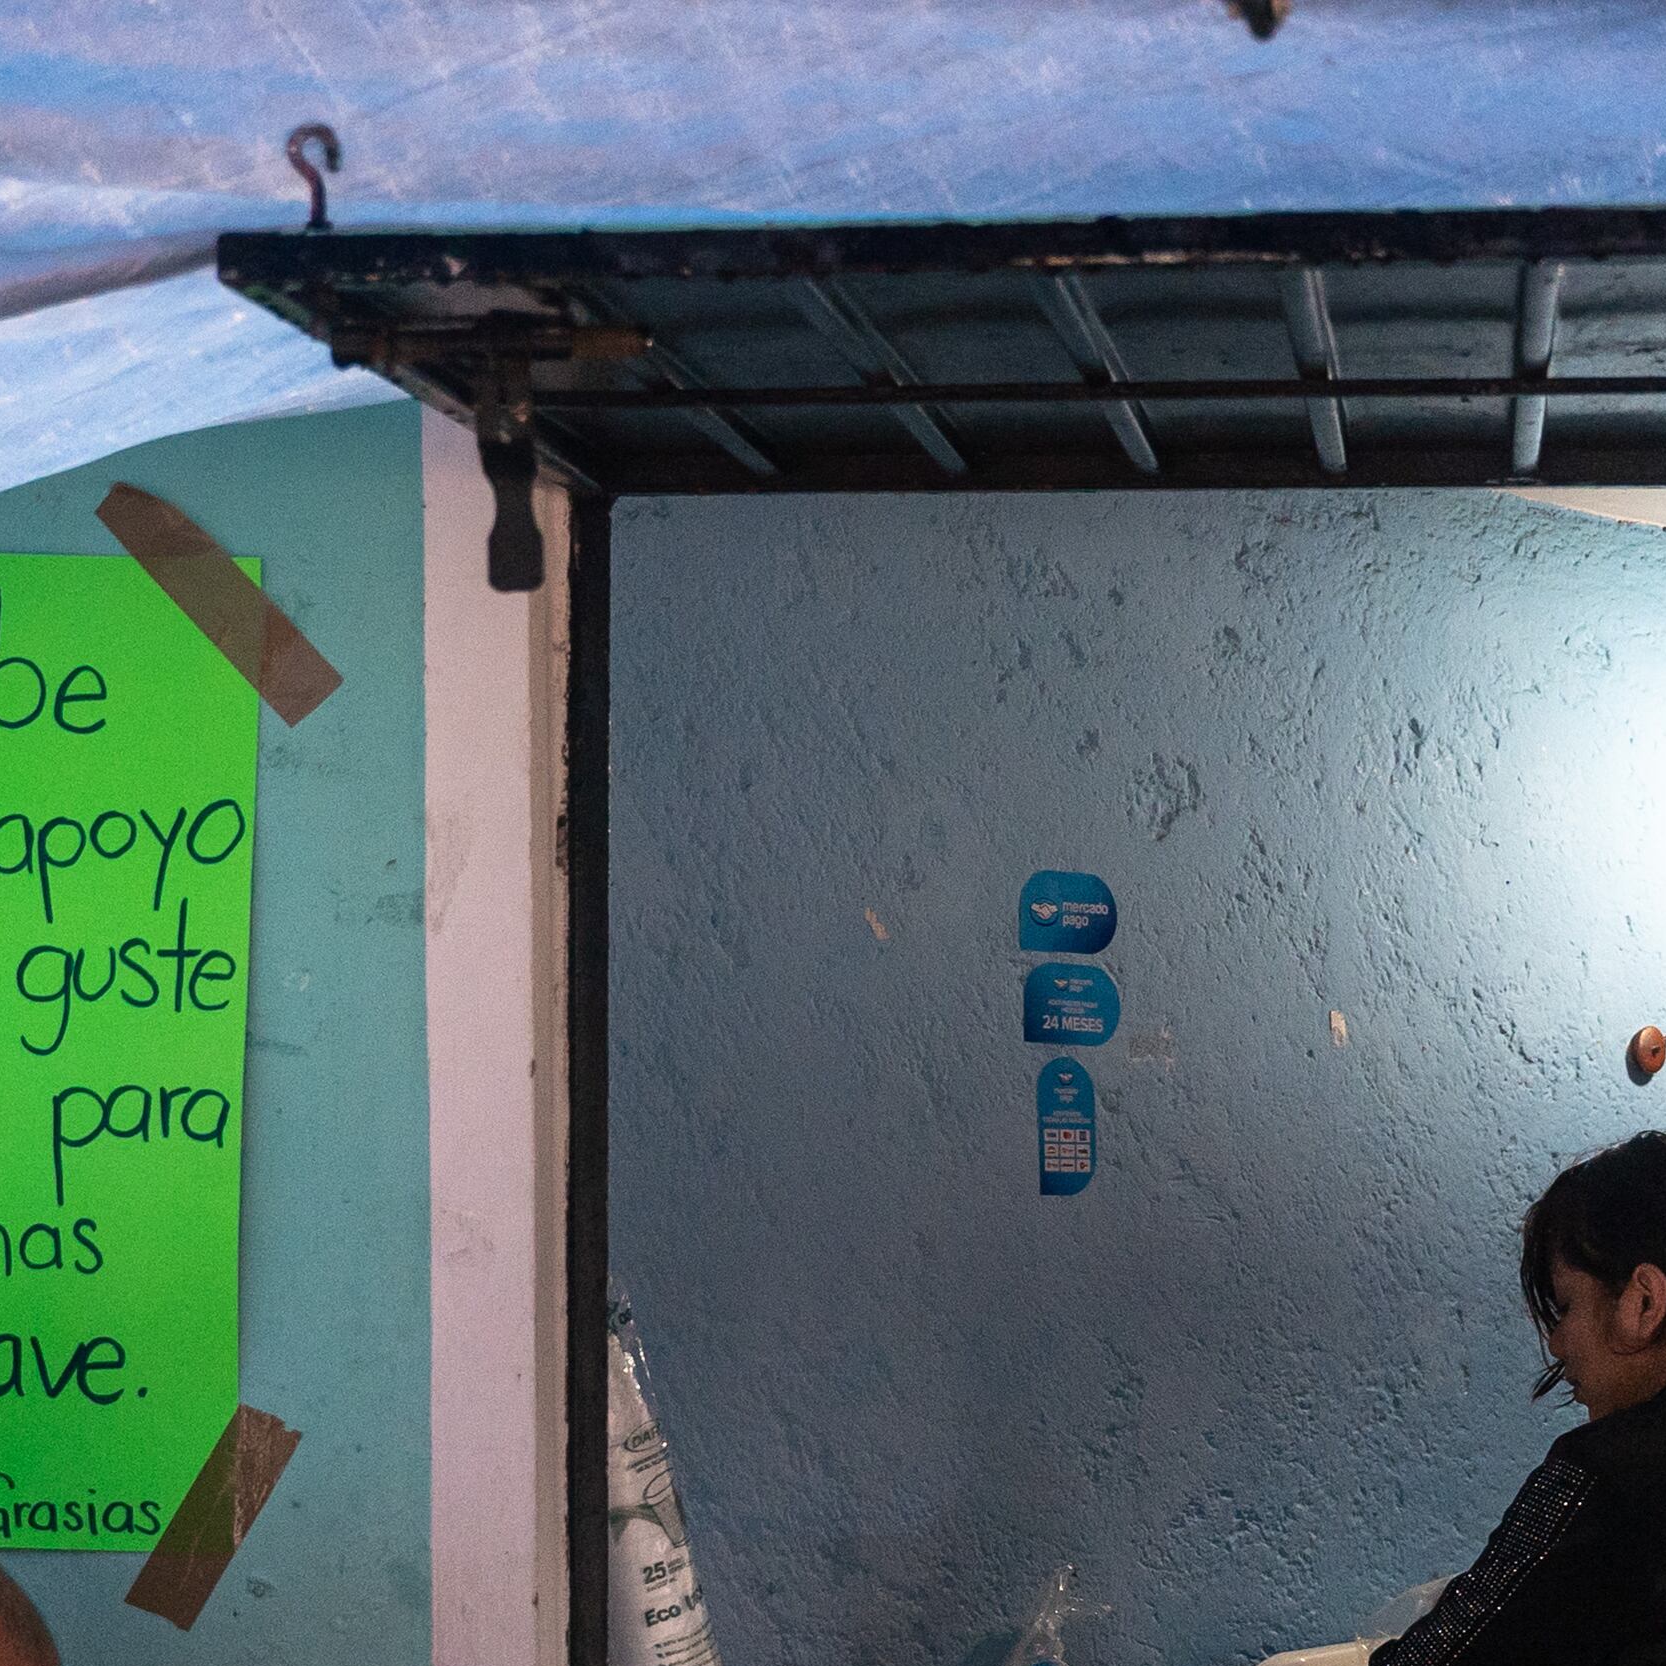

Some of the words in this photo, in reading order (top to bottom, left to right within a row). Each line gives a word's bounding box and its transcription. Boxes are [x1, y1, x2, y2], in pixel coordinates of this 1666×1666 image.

[1061, 901, 1109, 915] mercado
[1061, 914, 1089, 929] pago
[17, 897, 237, 1055] guste
[1042, 1014, 1059, 1030] 24
[1061, 1016, 1104, 1033] MESES
[52, 1082, 231, 1205] para
[642, 1560, 667, 1585] 25
[643, 1603, 682, 1628] Eco
